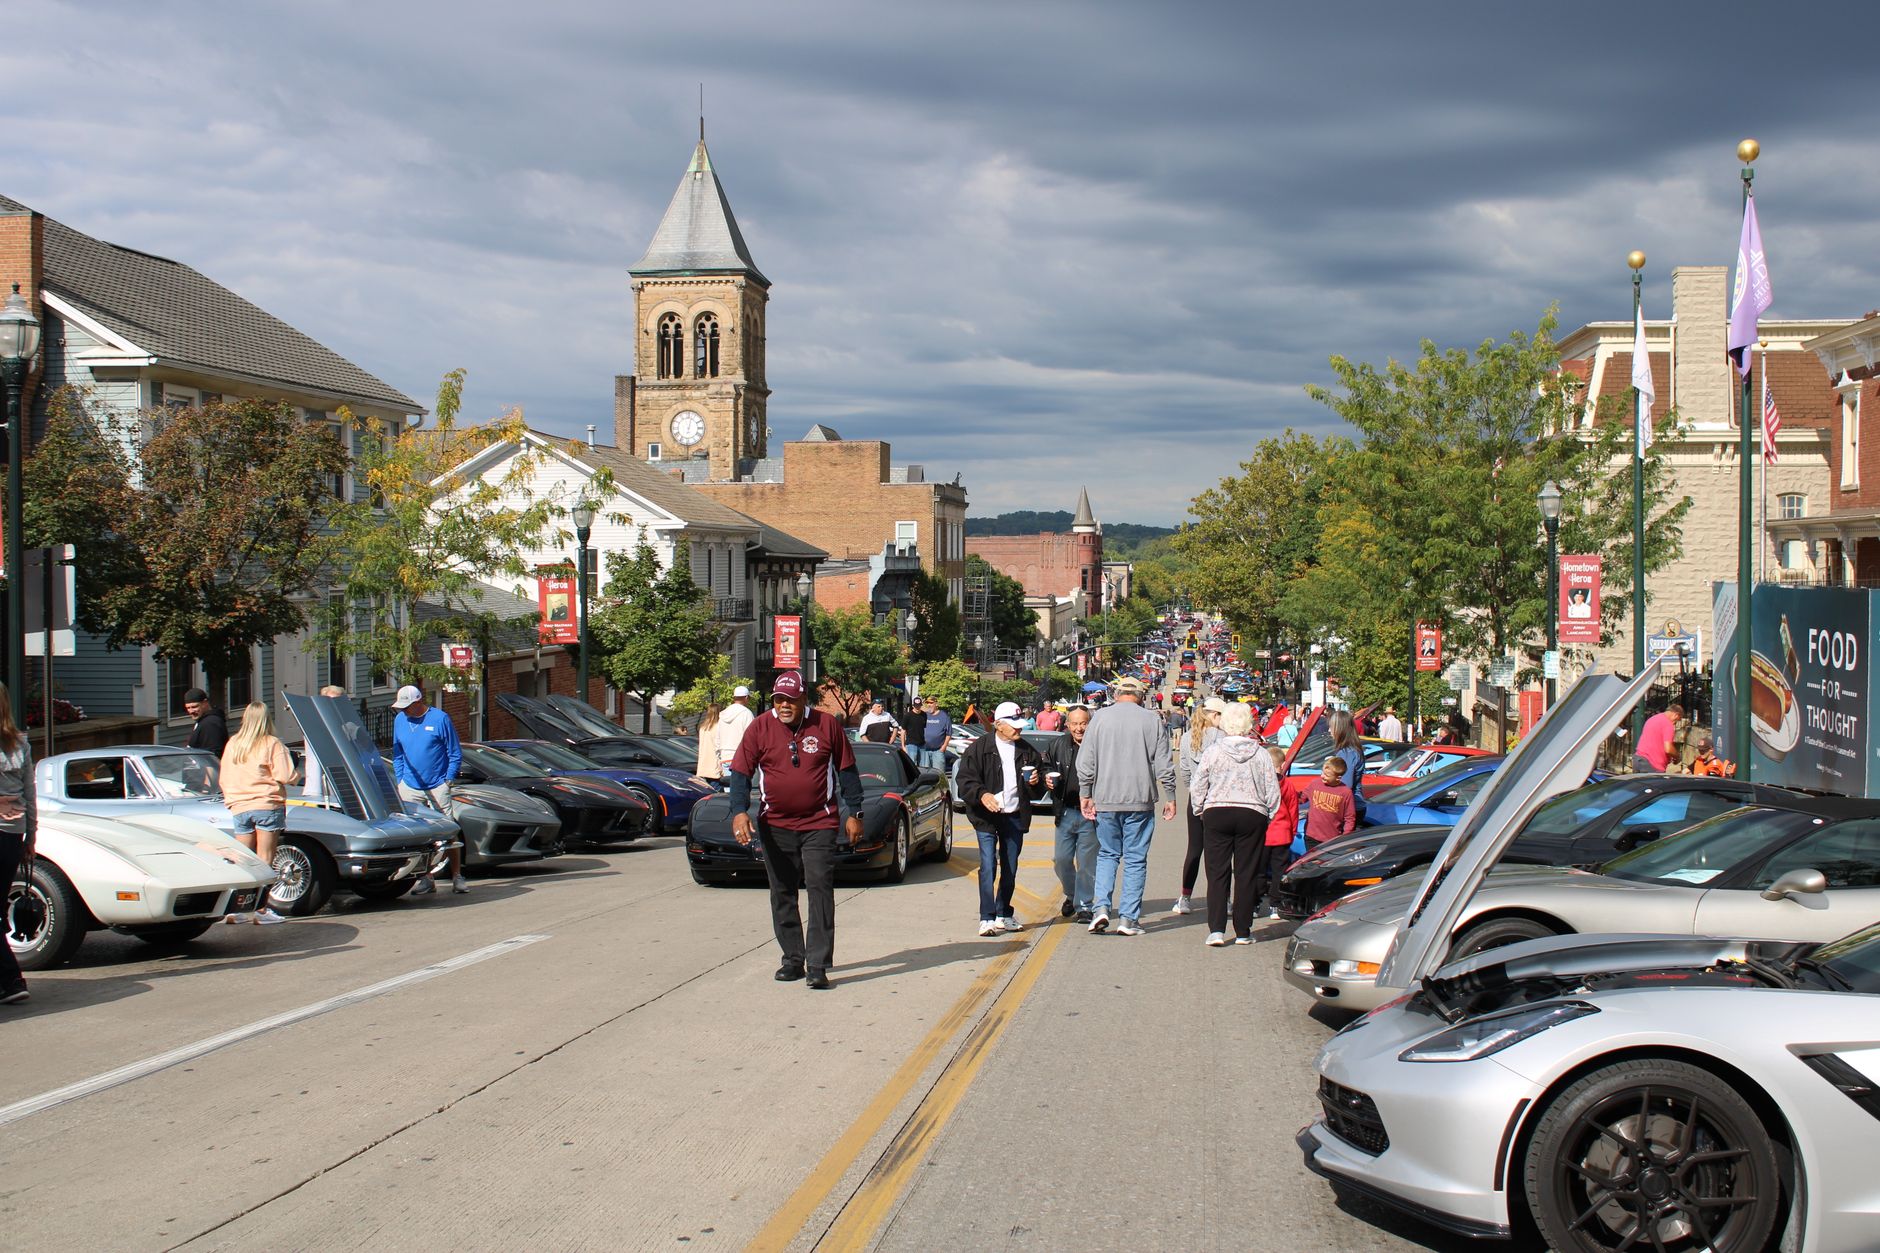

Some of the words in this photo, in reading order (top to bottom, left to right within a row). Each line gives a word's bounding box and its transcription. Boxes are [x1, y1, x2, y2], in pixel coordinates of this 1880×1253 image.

[1560, 561, 1599, 575] Hometown
[1808, 628, 1857, 671] FOOD
[1821, 679, 1841, 700] FOR
[1806, 704, 1857, 740] THOUGHT
